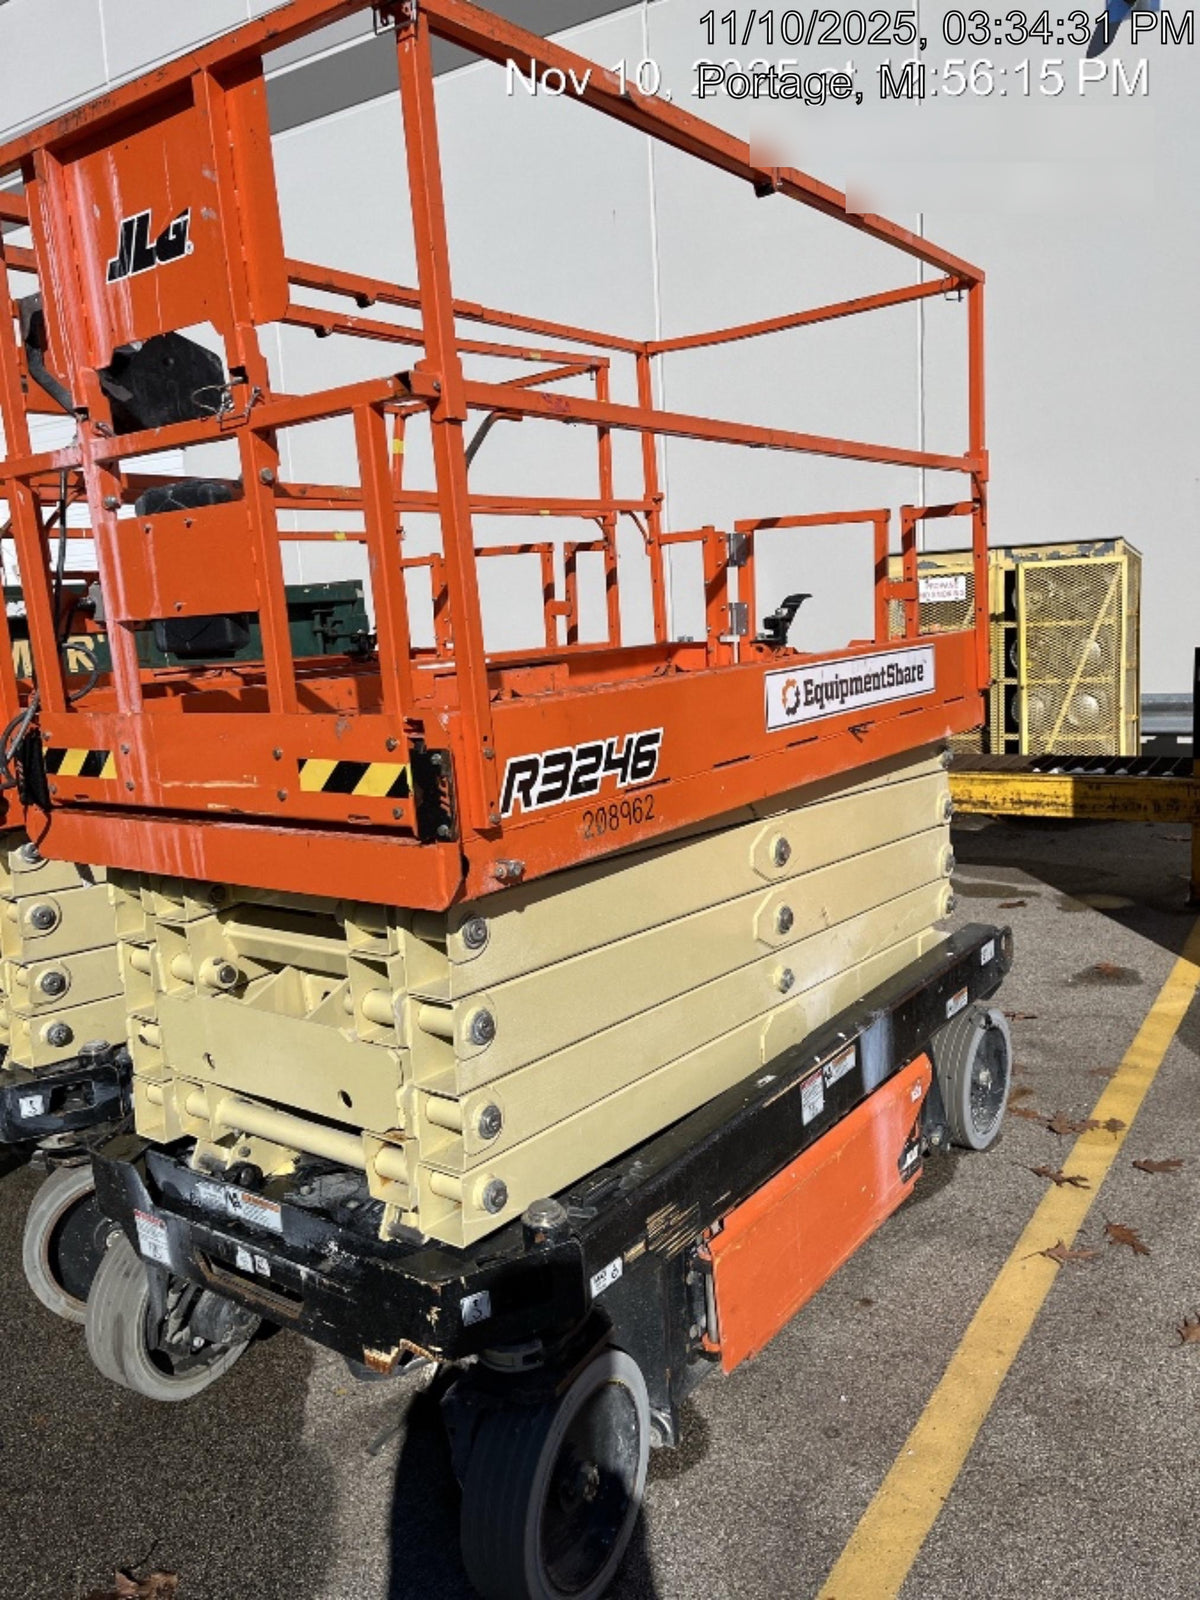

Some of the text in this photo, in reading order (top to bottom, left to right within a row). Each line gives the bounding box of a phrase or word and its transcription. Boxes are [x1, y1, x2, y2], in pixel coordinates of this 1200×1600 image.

[106, 207, 191, 285] JLG
[803, 661, 924, 710] EquipmentShare
[500, 727, 664, 818] R3246
[582, 794, 655, 840] 208962
